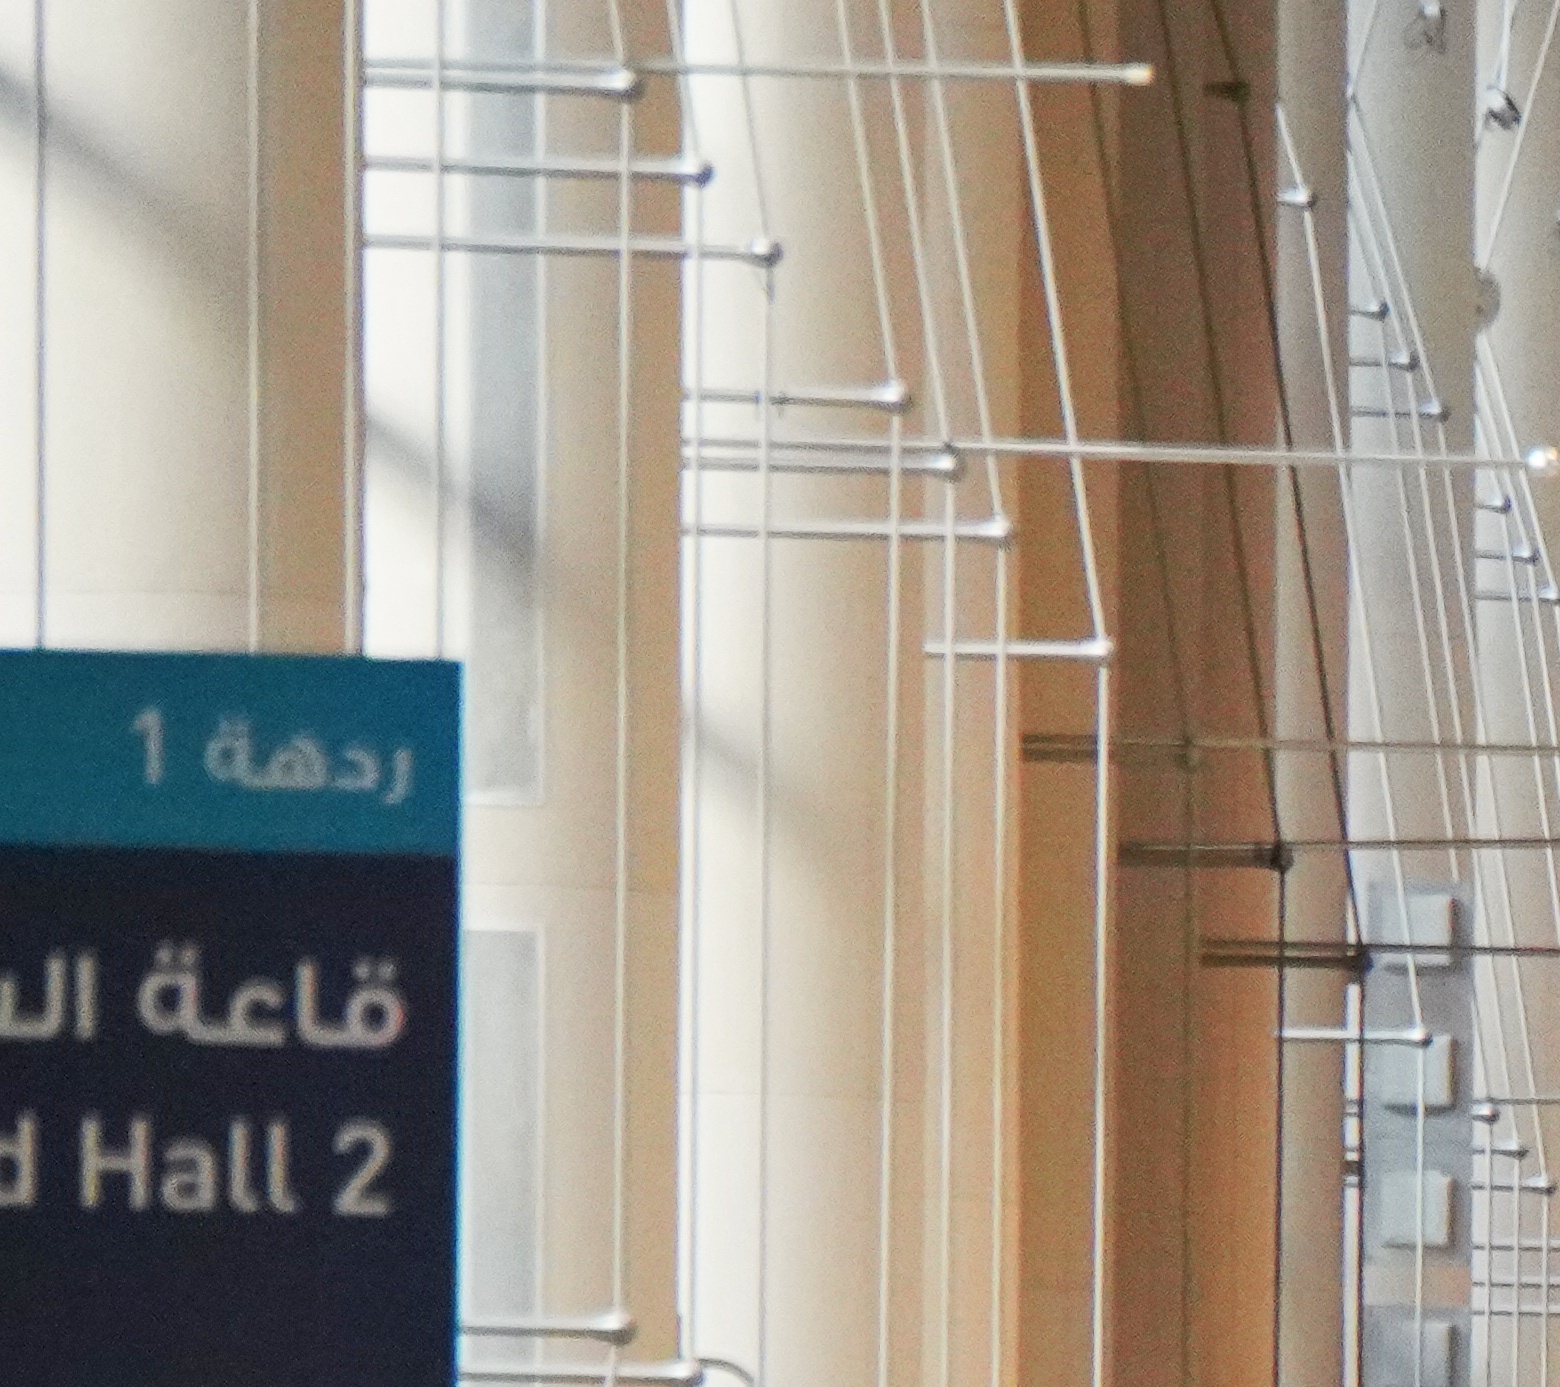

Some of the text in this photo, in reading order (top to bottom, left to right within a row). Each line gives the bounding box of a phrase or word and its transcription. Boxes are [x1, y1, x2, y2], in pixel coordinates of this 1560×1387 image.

[134, 708, 414, 804] ردهة 1
[137, 941, 405, 1048] قاعة
[81, 1111, 392, 1218] Hall 2
